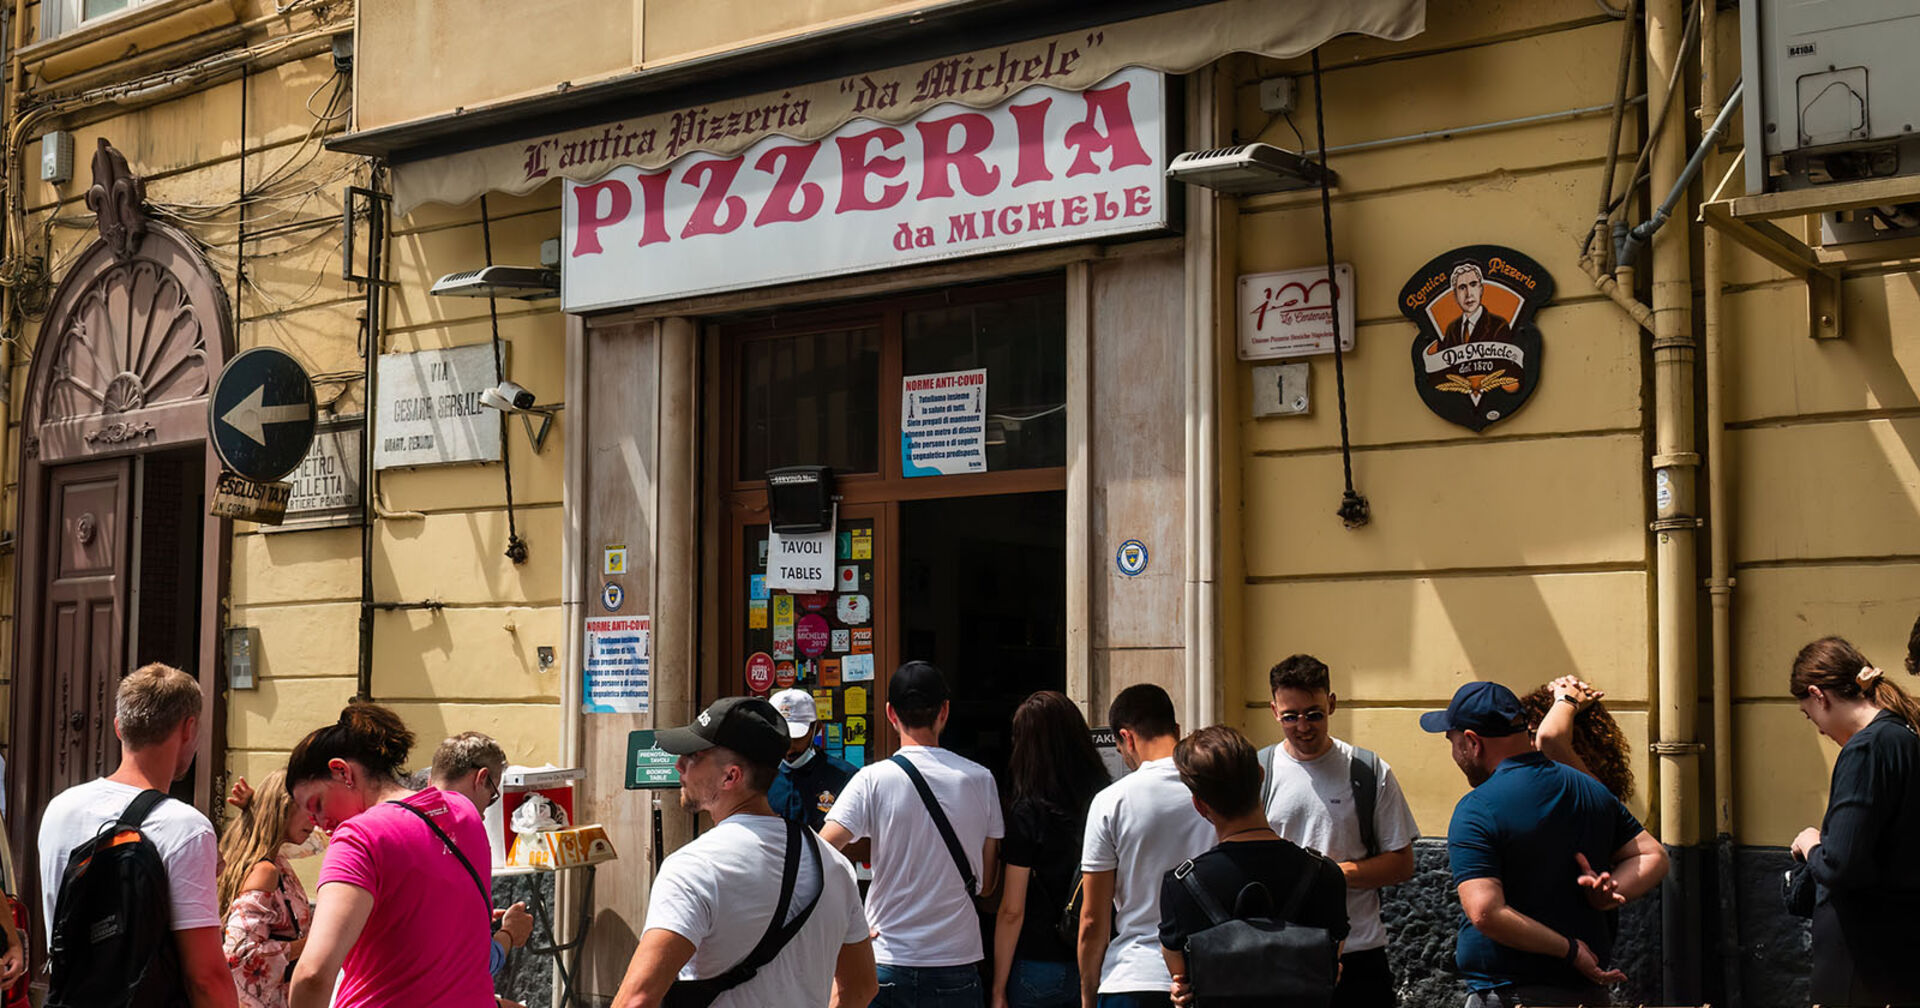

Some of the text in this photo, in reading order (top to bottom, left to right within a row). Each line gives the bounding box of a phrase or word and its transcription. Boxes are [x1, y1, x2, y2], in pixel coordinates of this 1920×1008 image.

[524, 123, 656, 180] L'antica
[667, 91, 811, 159] Pizzeria
[572, 81, 1153, 258] PIZZERIA
[893, 185, 1152, 251] da MICHELE
[1488, 257, 1537, 290] Pizzeria
[1442, 349, 1465, 366] Da
[1473, 361, 1494, 371] 1870
[431, 361, 448, 382] VIA
[906, 373, 984, 391] NORME ANTI-COVID
[394, 391, 484, 423] CESARE SERSALE
[308, 437, 324, 456] IA
[294, 456, 334, 478] IETRO
[220, 479, 291, 505] ESCLUSI TAXI
[293, 476, 342, 498] OLLETTA
[781, 540, 822, 554] TAVOLI
[780, 566, 822, 580] TABLES
[587, 621, 611, 632] NORME
[797, 632, 828, 640] MICHELIN
